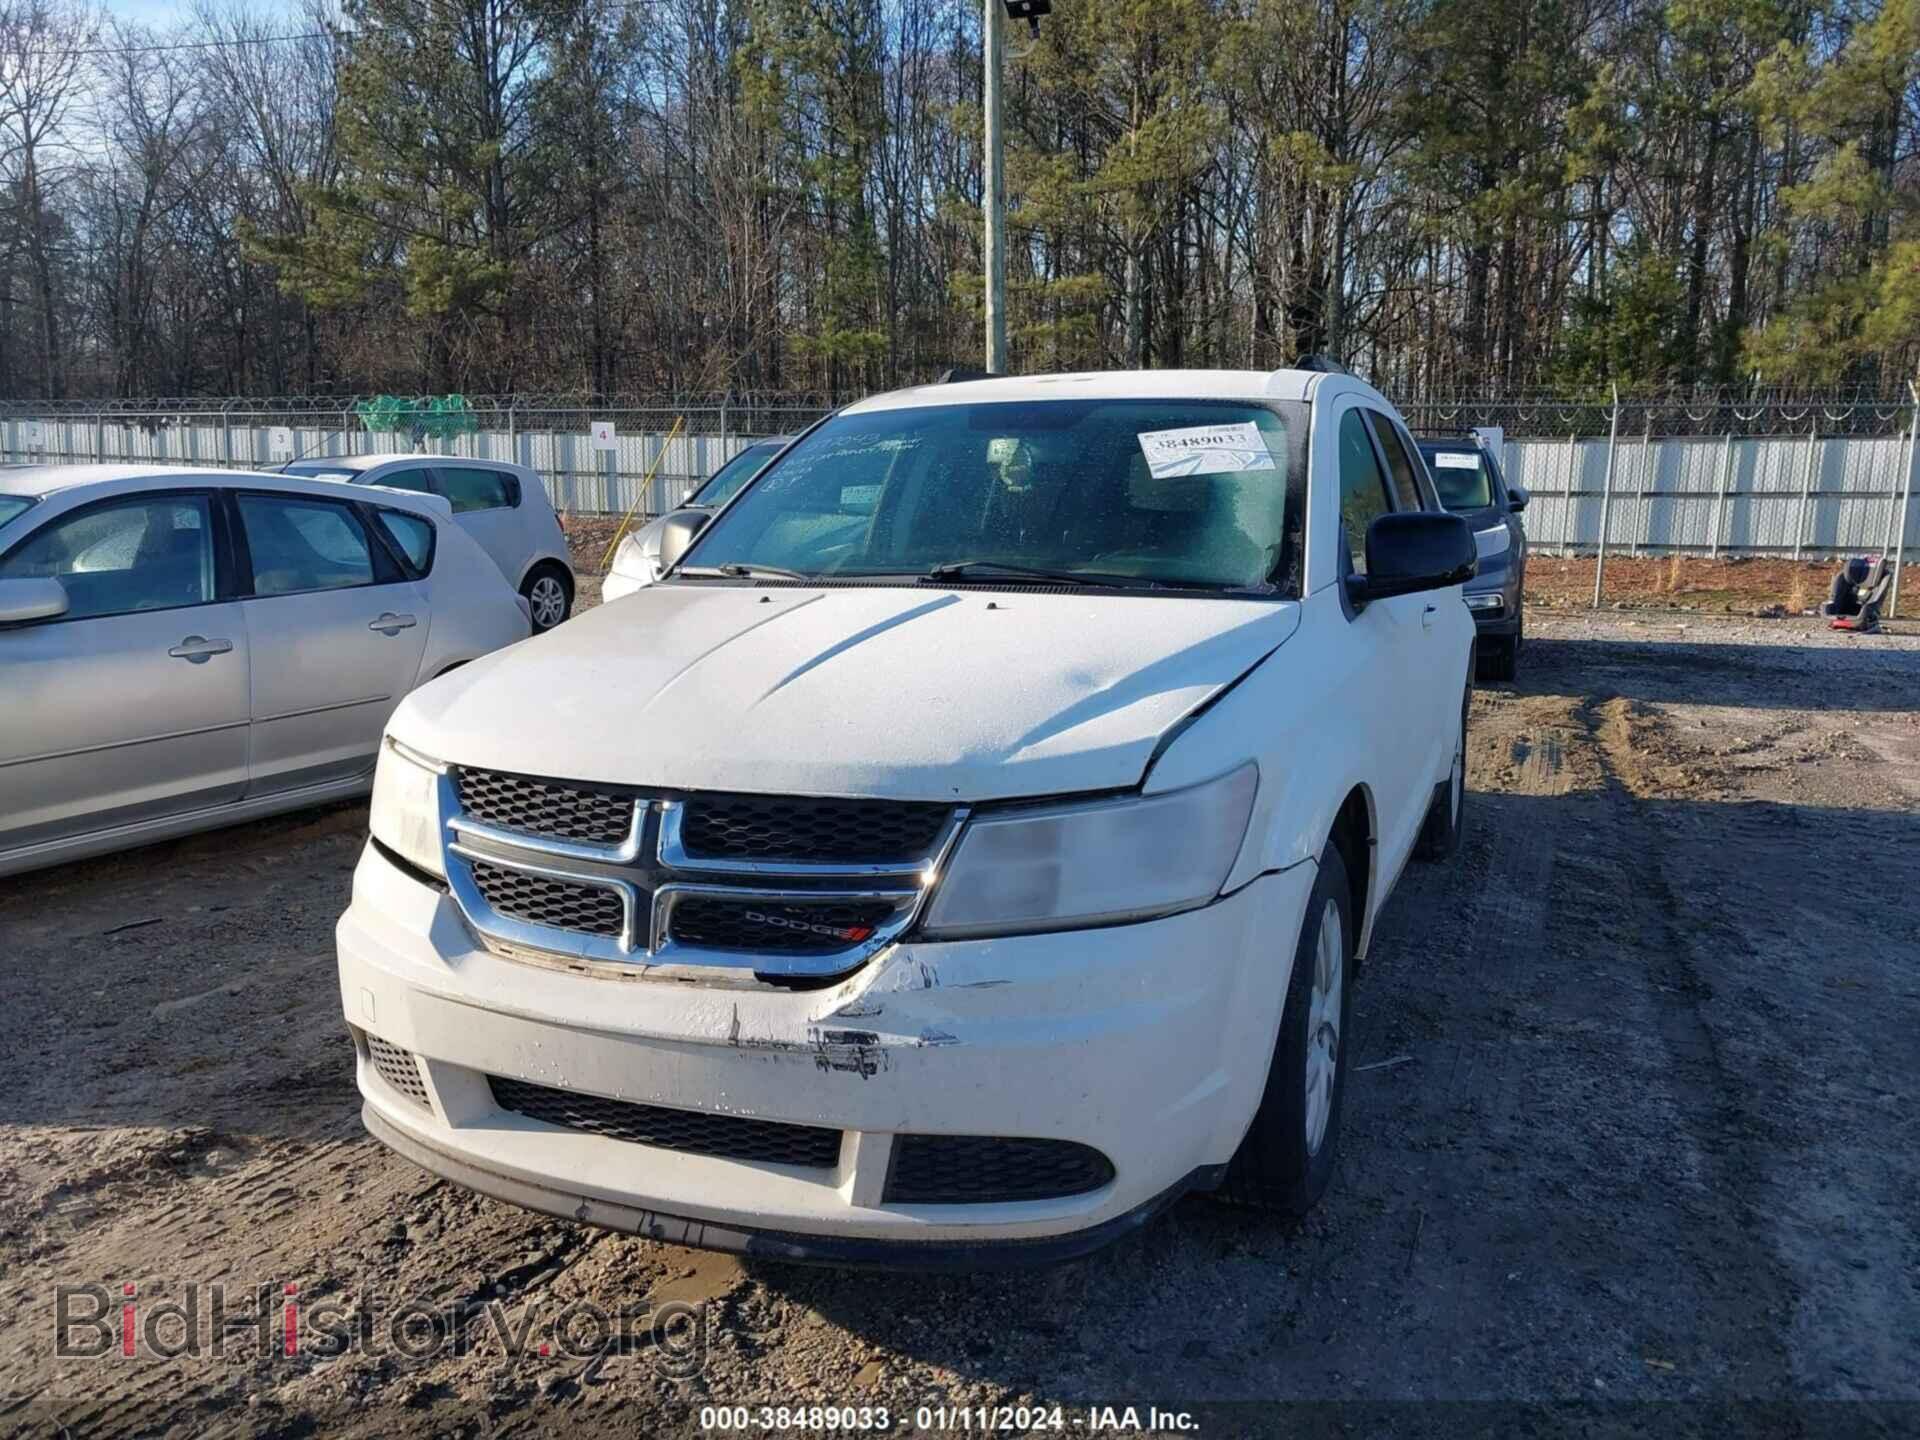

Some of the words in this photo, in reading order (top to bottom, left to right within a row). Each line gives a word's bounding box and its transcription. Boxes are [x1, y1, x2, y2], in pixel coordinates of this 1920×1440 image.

[278, 434, 285, 444] 3
[599, 430, 607, 440] 4
[1155, 434, 1247, 450] 38489033
[744, 911, 852, 939] DODGE
